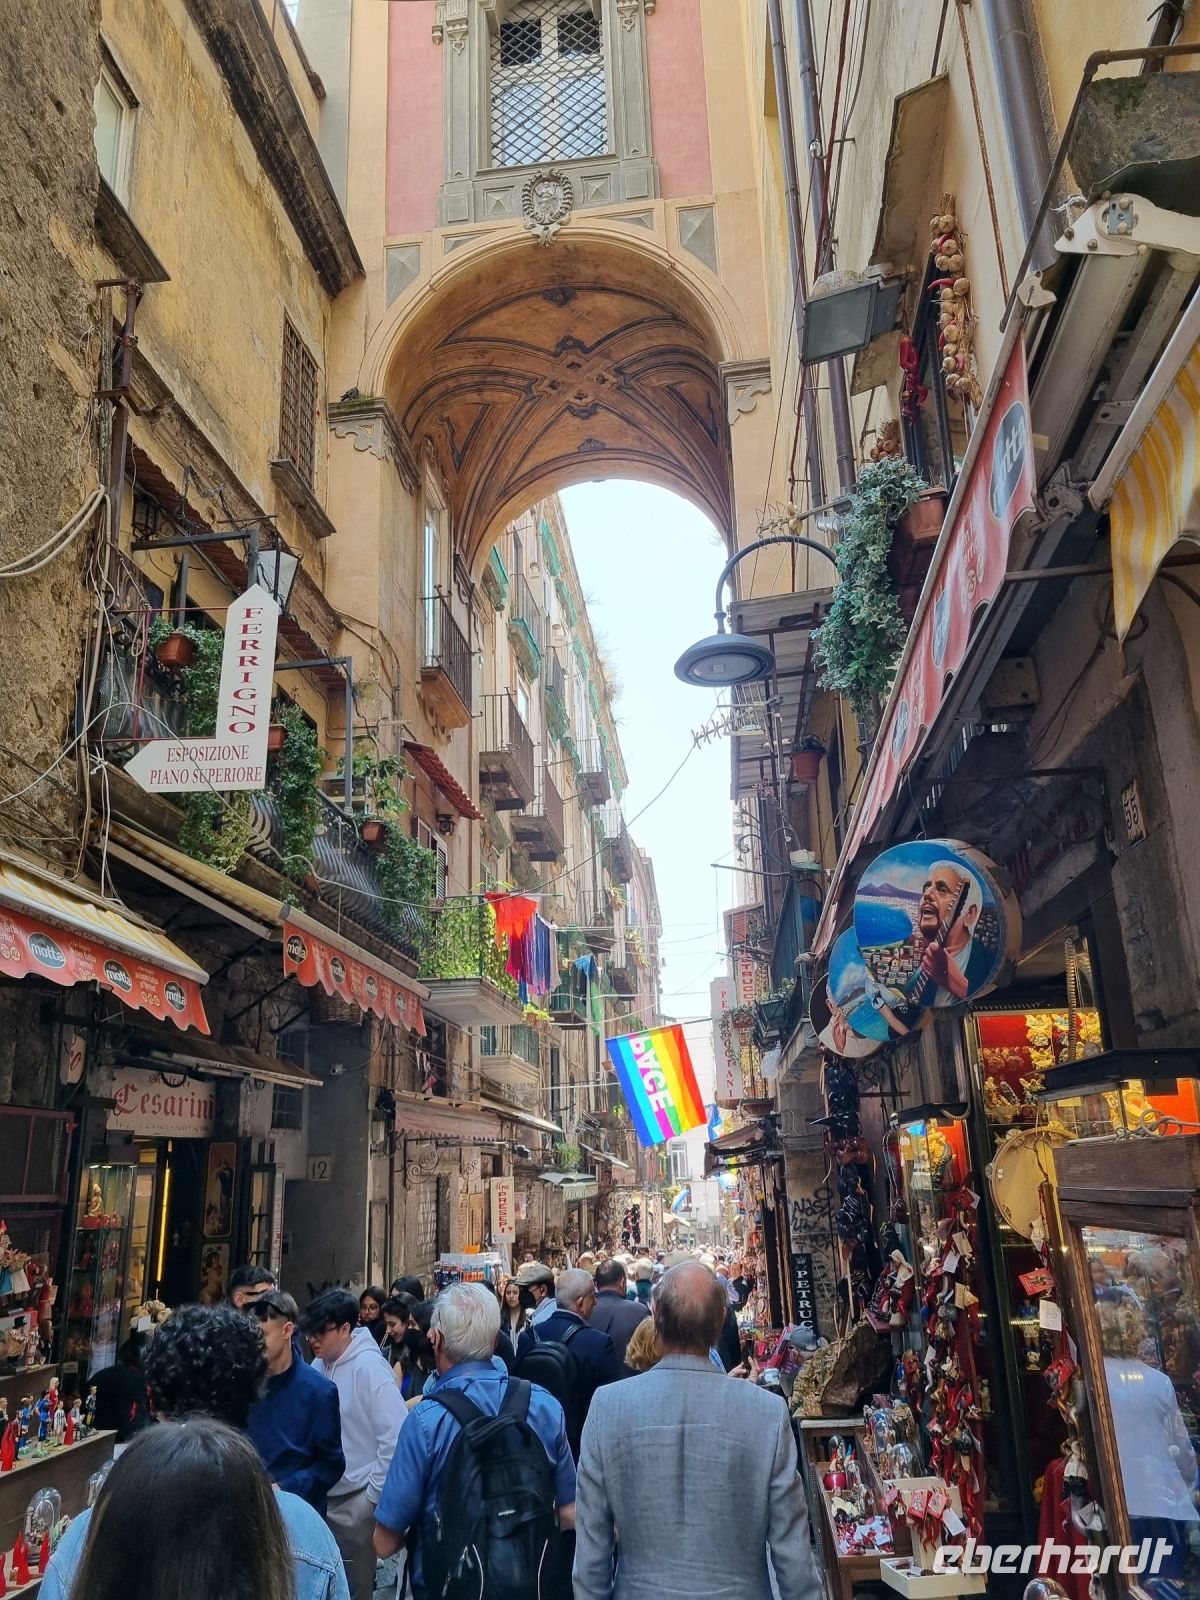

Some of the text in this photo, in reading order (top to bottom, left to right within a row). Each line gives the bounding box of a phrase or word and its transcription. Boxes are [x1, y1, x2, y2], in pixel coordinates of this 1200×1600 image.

[228, 607, 264, 734] FERRIGNO
[166, 745, 250, 763] ESPOSIZIONE
[150, 766, 263, 785] PIANO SUPERIORE
[1124, 796, 1139, 830] 55
[31, 943, 64, 962] motta
[106, 969, 131, 986] motta
[166, 990, 185, 1006] motta
[628, 1035, 675, 1112] PACE
[114, 1083, 214, 1119] Cesarini
[312, 1161, 328, 1179] 12
[498, 1191, 508, 1233] PRESEPI
